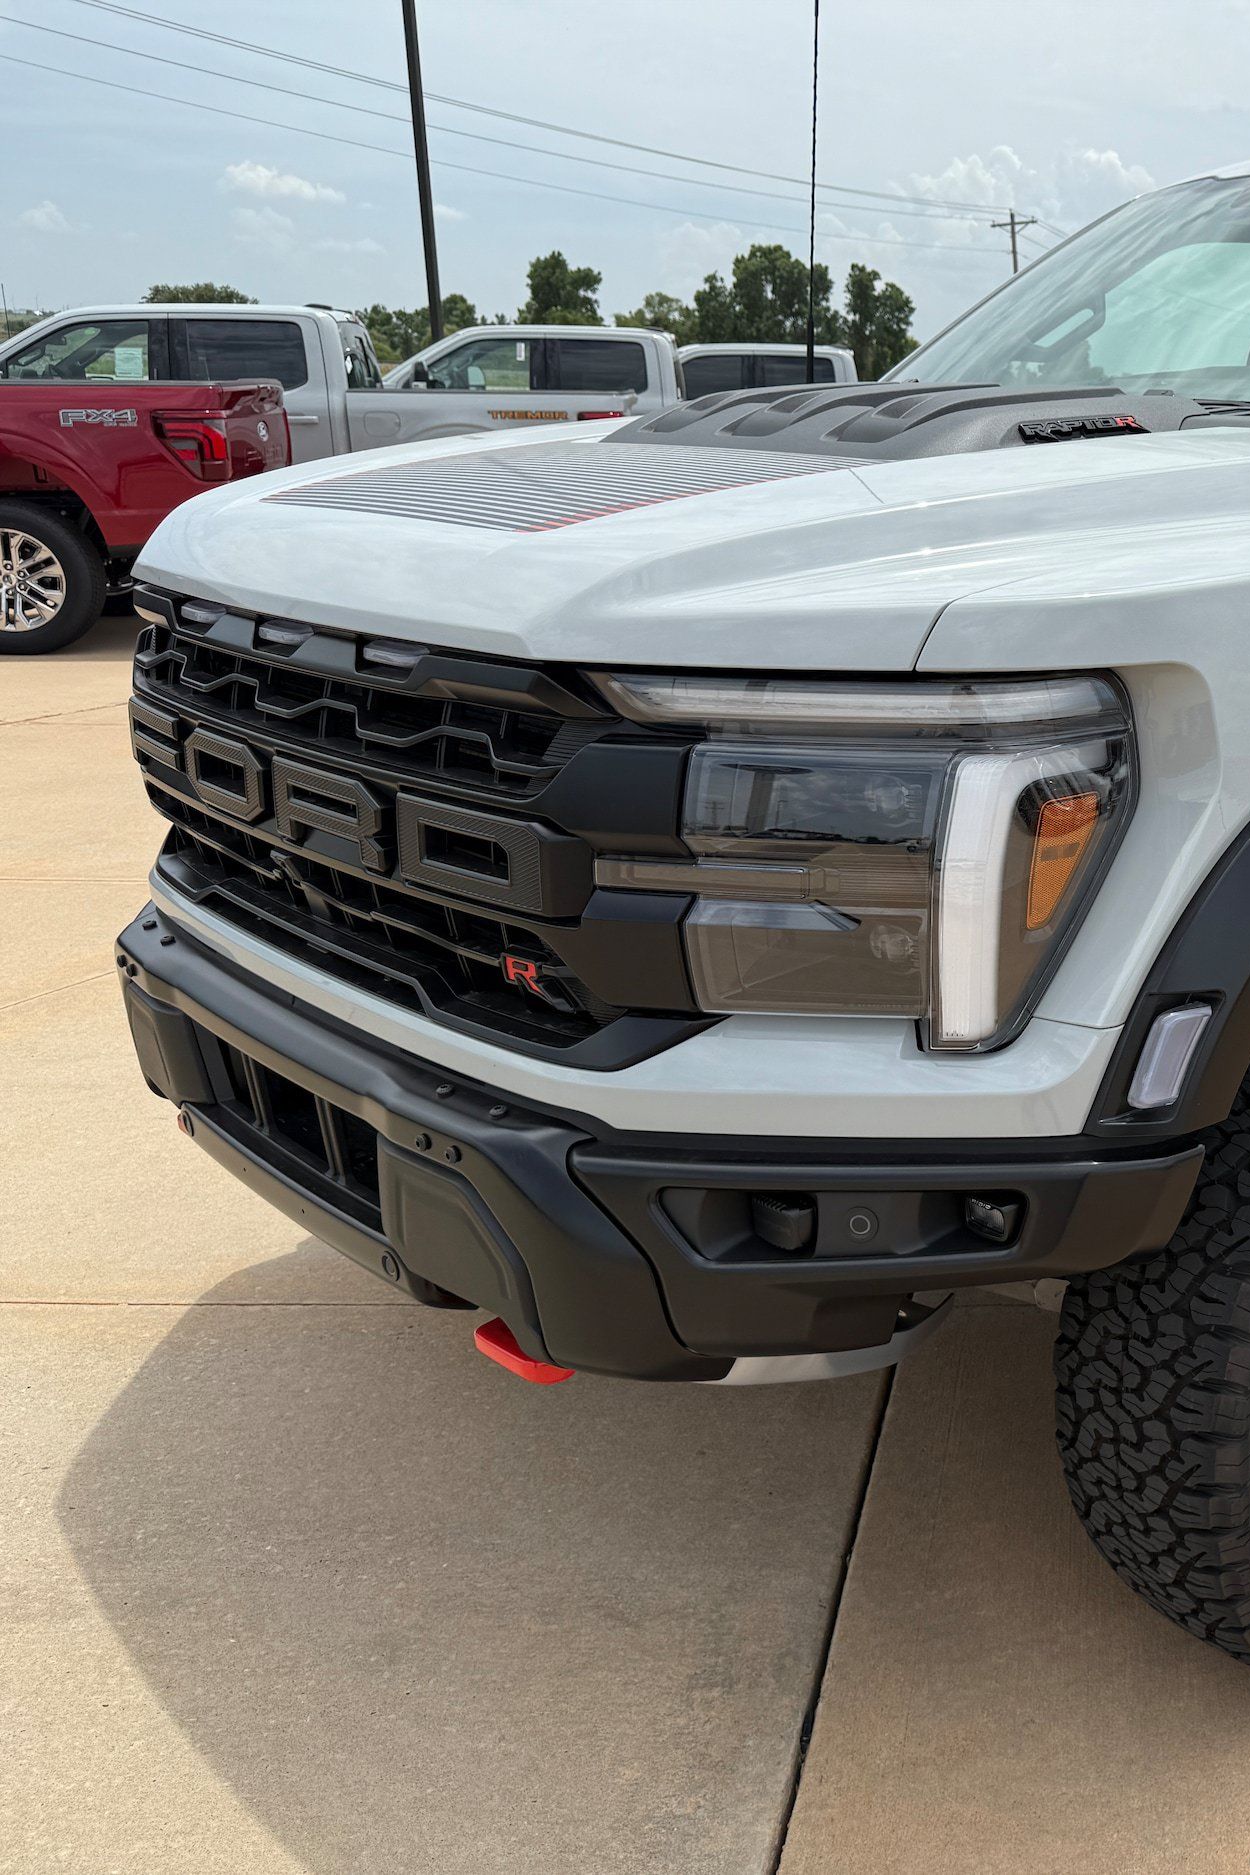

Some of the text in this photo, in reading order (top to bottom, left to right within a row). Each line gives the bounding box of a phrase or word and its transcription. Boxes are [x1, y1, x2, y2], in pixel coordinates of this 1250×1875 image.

[60, 408, 138, 428] FX4
[488, 410, 568, 421] TREMOR
[1018, 415, 1151, 443] RAPTOR
[129, 695, 544, 912] FORD
[502, 953, 550, 1001] R
